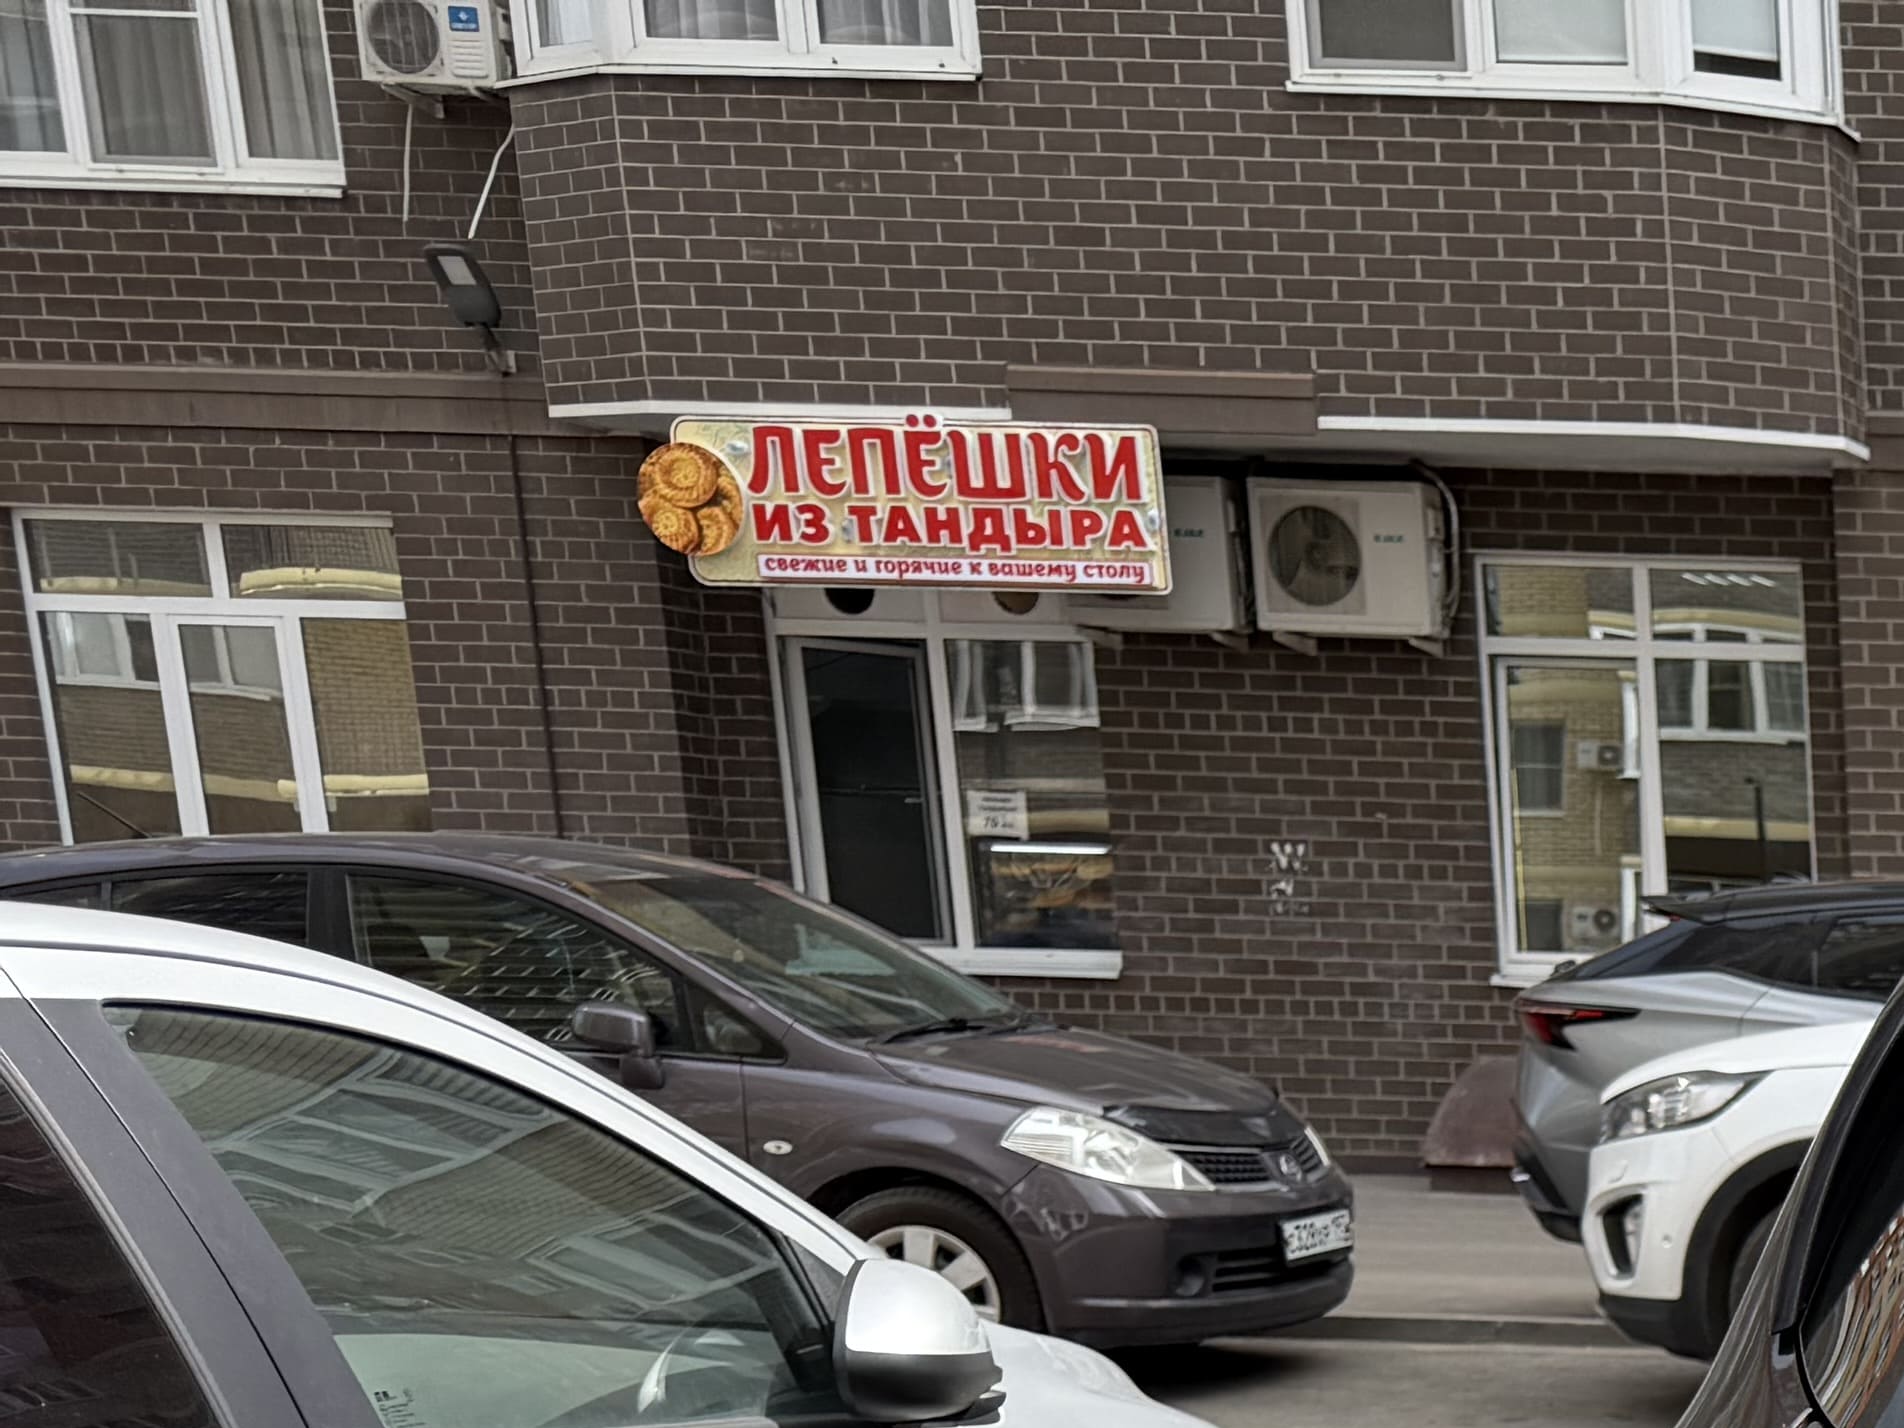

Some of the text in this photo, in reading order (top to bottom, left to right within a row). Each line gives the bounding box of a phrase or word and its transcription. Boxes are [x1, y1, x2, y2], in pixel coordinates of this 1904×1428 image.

[747, 413, 1142, 501] ЛЕПЁШКИ
[753, 502, 1147, 553] ИЗ ТАНДЫРА
[764, 556, 1145, 584] свежие и горячие к вашему столу
